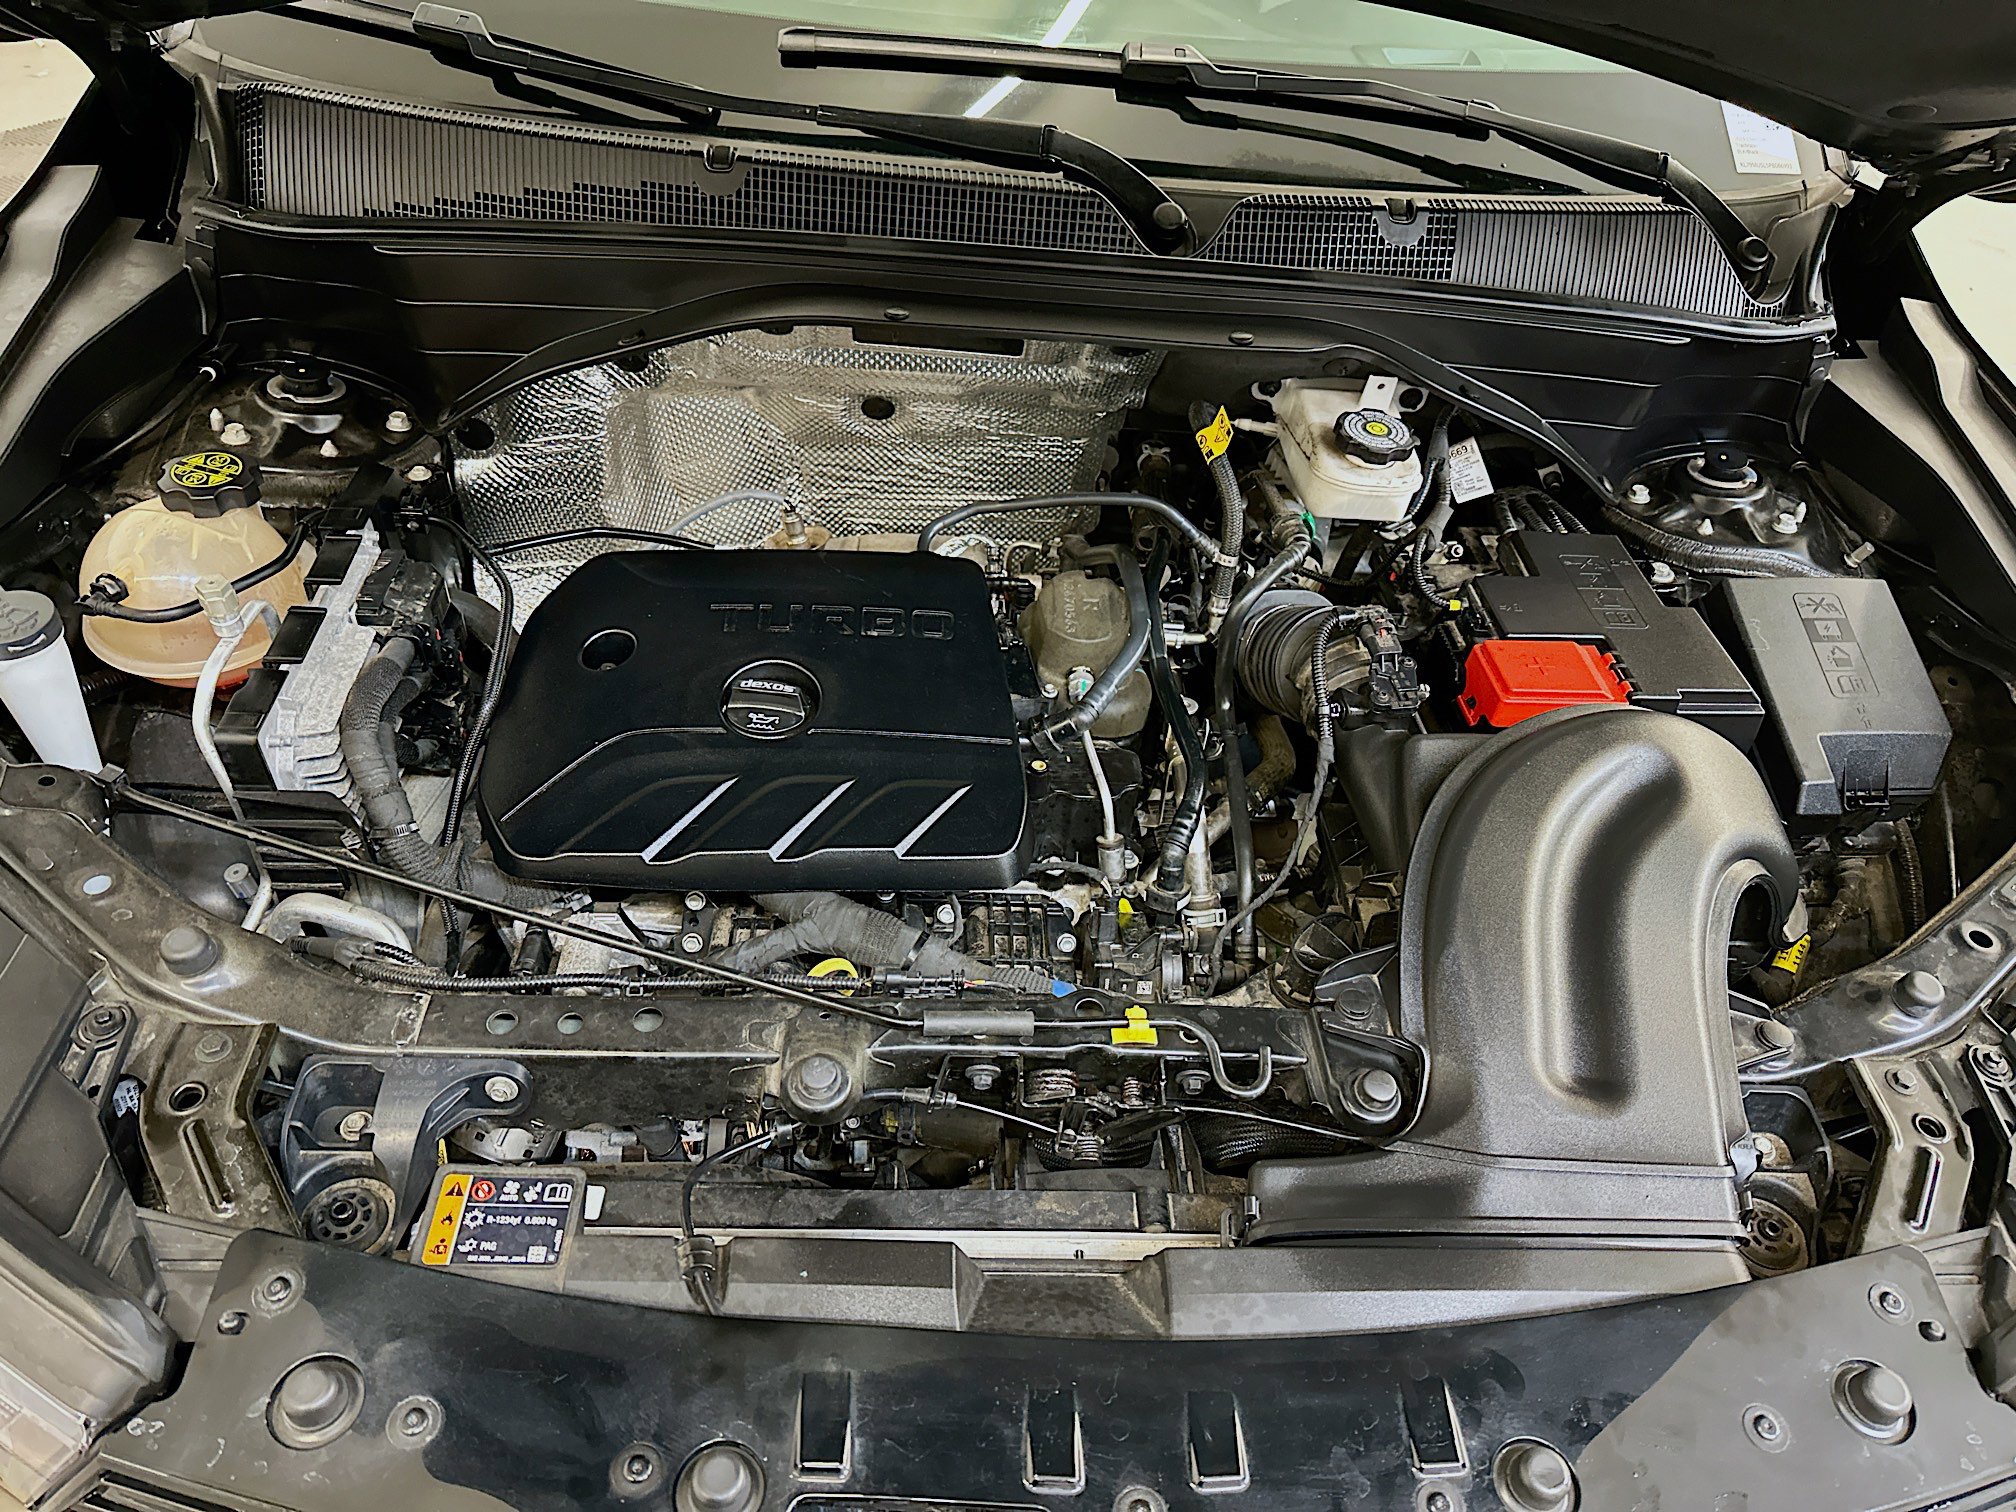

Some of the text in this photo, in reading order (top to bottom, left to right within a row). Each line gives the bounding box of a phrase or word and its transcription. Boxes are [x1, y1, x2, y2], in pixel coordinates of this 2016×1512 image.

[710, 603, 955, 640] TURBO
[740, 679, 797, 693] dexos
[499, 1194, 519, 1202] AUTO
[486, 1215, 522, 1227] R-1234yf
[480, 1241, 497, 1251] PAG
